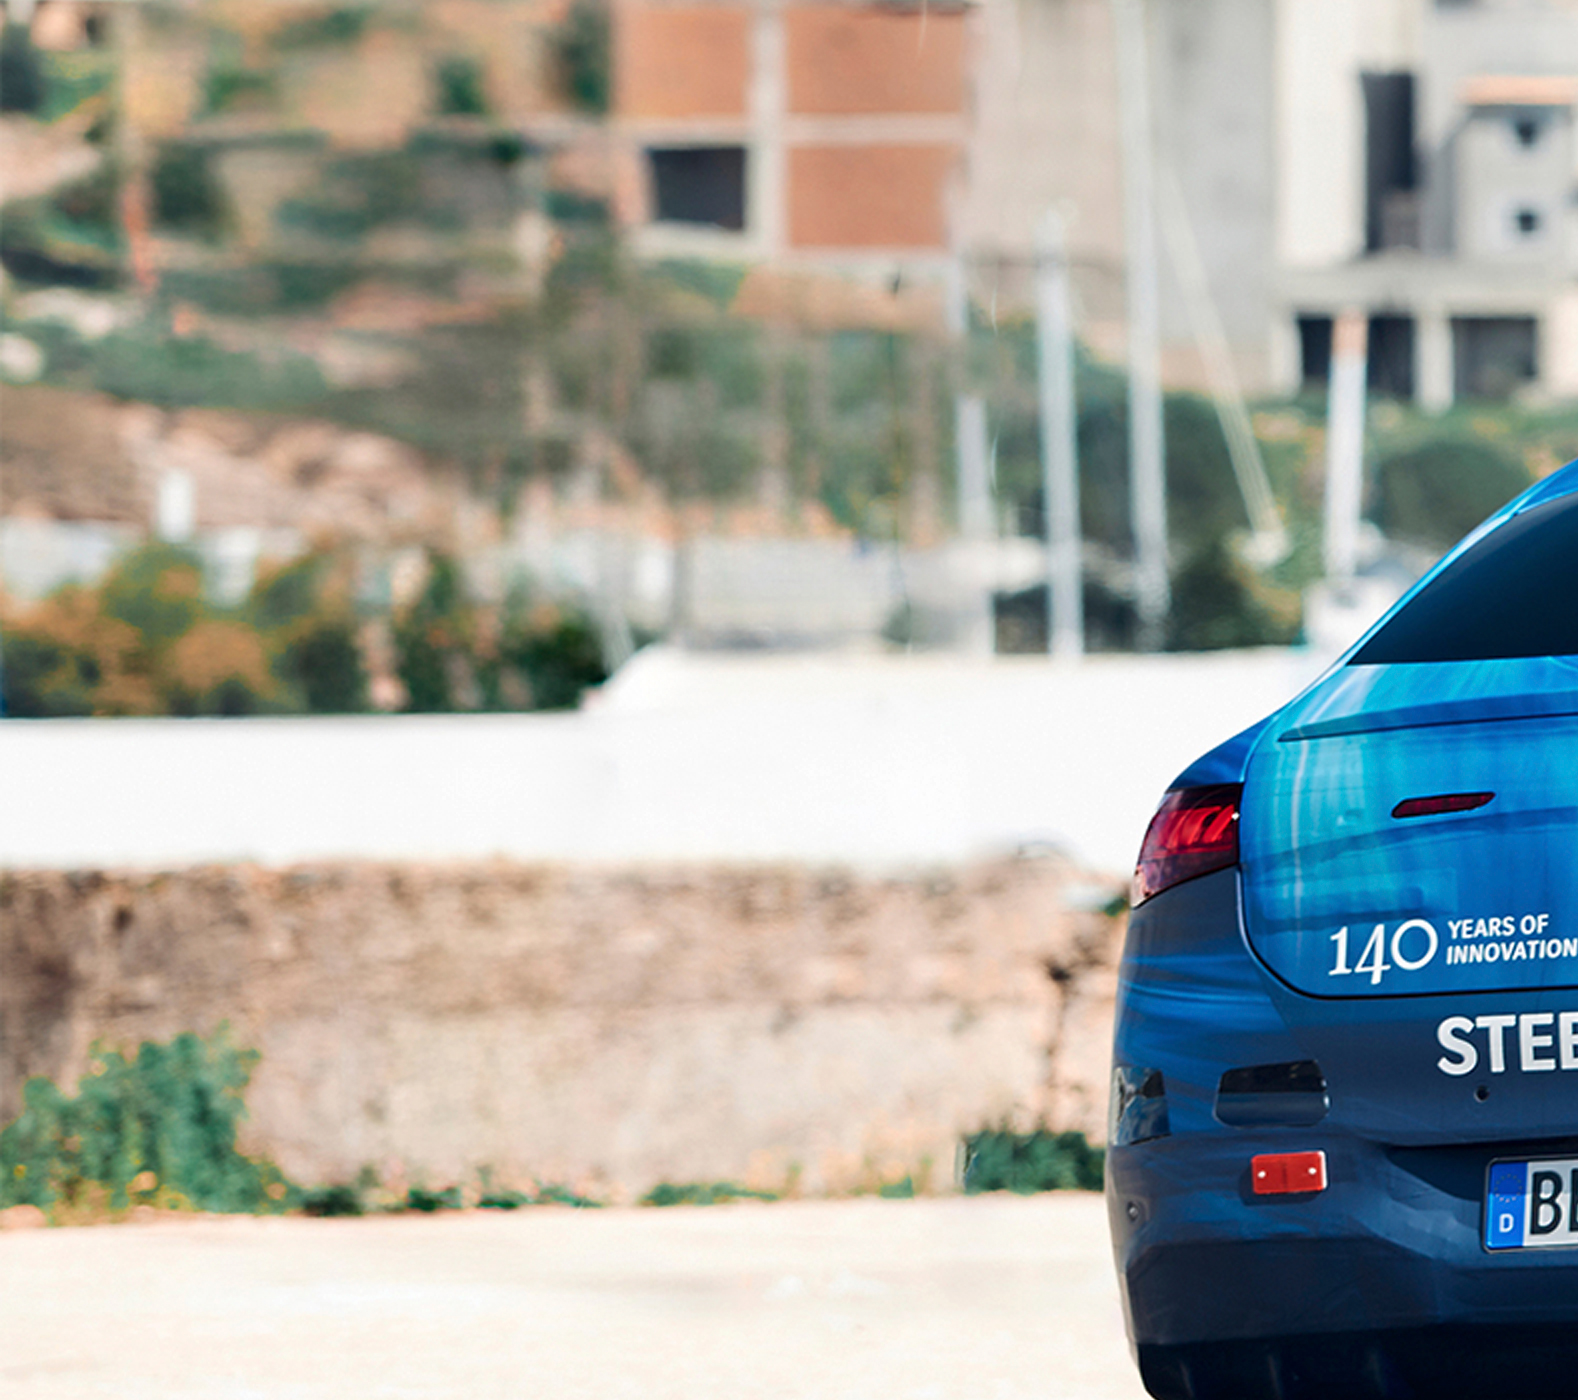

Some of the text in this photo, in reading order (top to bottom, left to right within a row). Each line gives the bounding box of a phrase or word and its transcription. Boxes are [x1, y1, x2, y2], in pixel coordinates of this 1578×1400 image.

[1447, 913, 1550, 941] YEARS OF
[1327, 918, 1439, 985] 140
[1498, 1212, 1515, 1234] D
